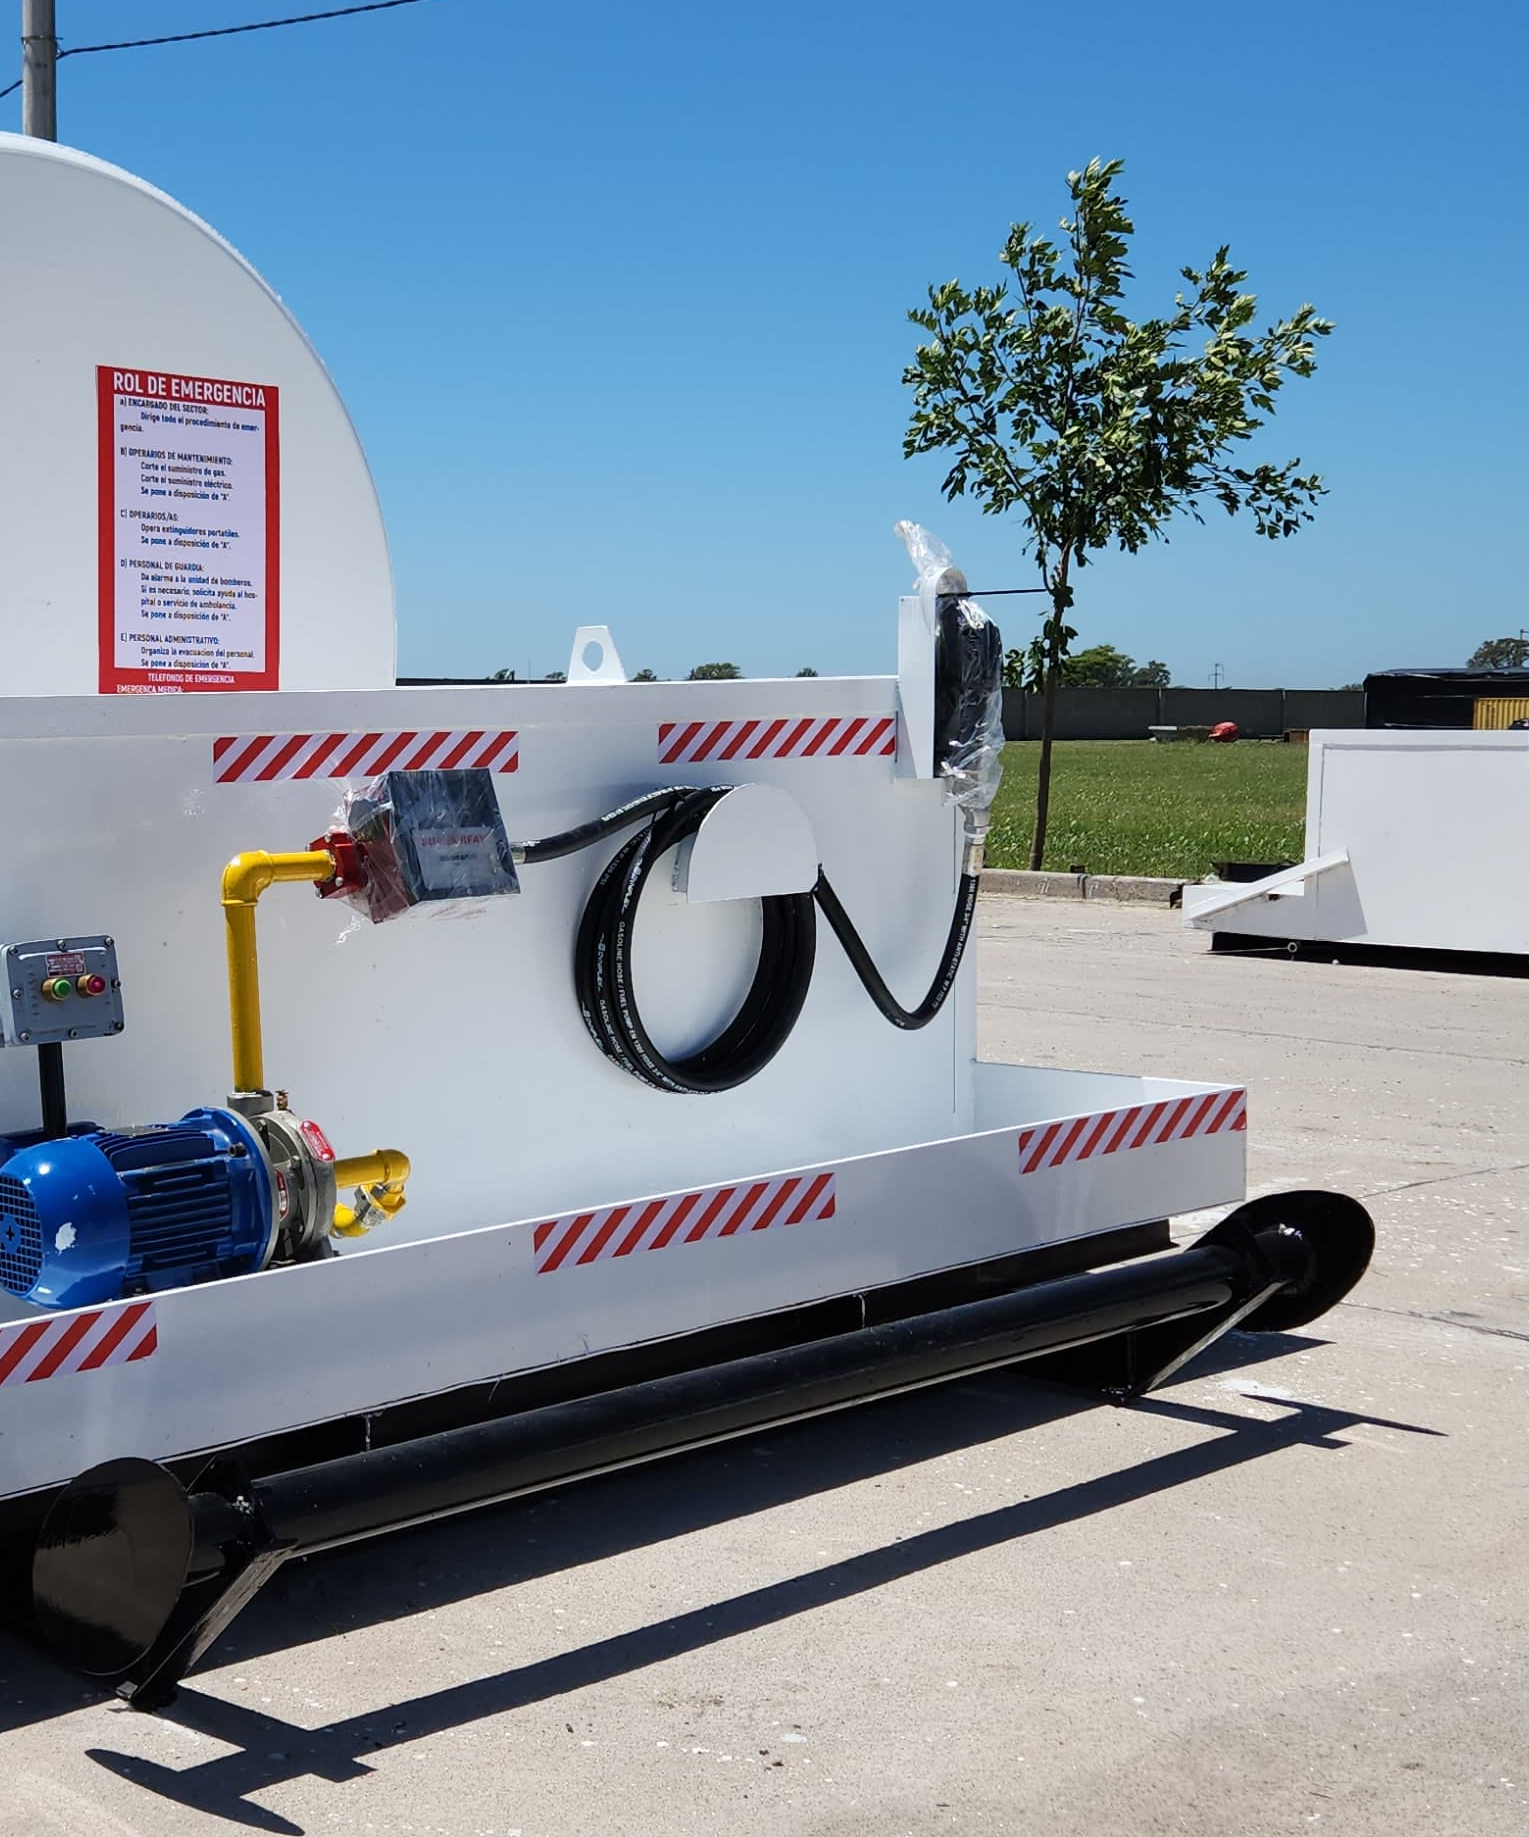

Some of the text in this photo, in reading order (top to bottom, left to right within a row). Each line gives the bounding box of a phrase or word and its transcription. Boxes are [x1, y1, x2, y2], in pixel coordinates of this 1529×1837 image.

[114, 372, 265, 406] ROL DE EMERGENCIA
[128, 398, 168, 410] ENCARGADO
[170, 402, 181, 412] DEL
[183, 403, 209, 414] SECTOR:
[141, 412, 160, 423] Dirige
[162, 414, 176, 423] todo
[185, 417, 231, 429] procedimiento
[232, 421, 240, 430] de
[129, 448, 166, 459] OPERARIOS
[168, 451, 176, 460] DE
[141, 461, 159, 471] Corte
[141, 474, 159, 483] Corte
[211, 491, 219, 500] de
[141, 523, 160, 533] Opera
[211, 540, 219, 549] de
[129, 560, 163, 570] PERSONAL
[165, 562, 172, 571] DE
[151, 574, 173, 583] alarma
[211, 576, 218, 585] de
[192, 587, 216, 597] solicita
[217, 589, 236, 599] ayuda
[141, 597, 155, 607] pital
[163, 599, 188, 608] servicio
[190, 599, 198, 608] de
[150, 611, 166, 620] pone
[211, 612, 219, 621] de
[129, 634, 163, 643] PERSONAL
[211, 661, 219, 669] de
[185, 674, 193, 683] DE
[616, 921, 626, 962] GASOLINE
[616, 962, 624, 984] HOSE
[618, 989, 627, 1008] FUEL
[600, 999, 614, 1035] GASOLINE
